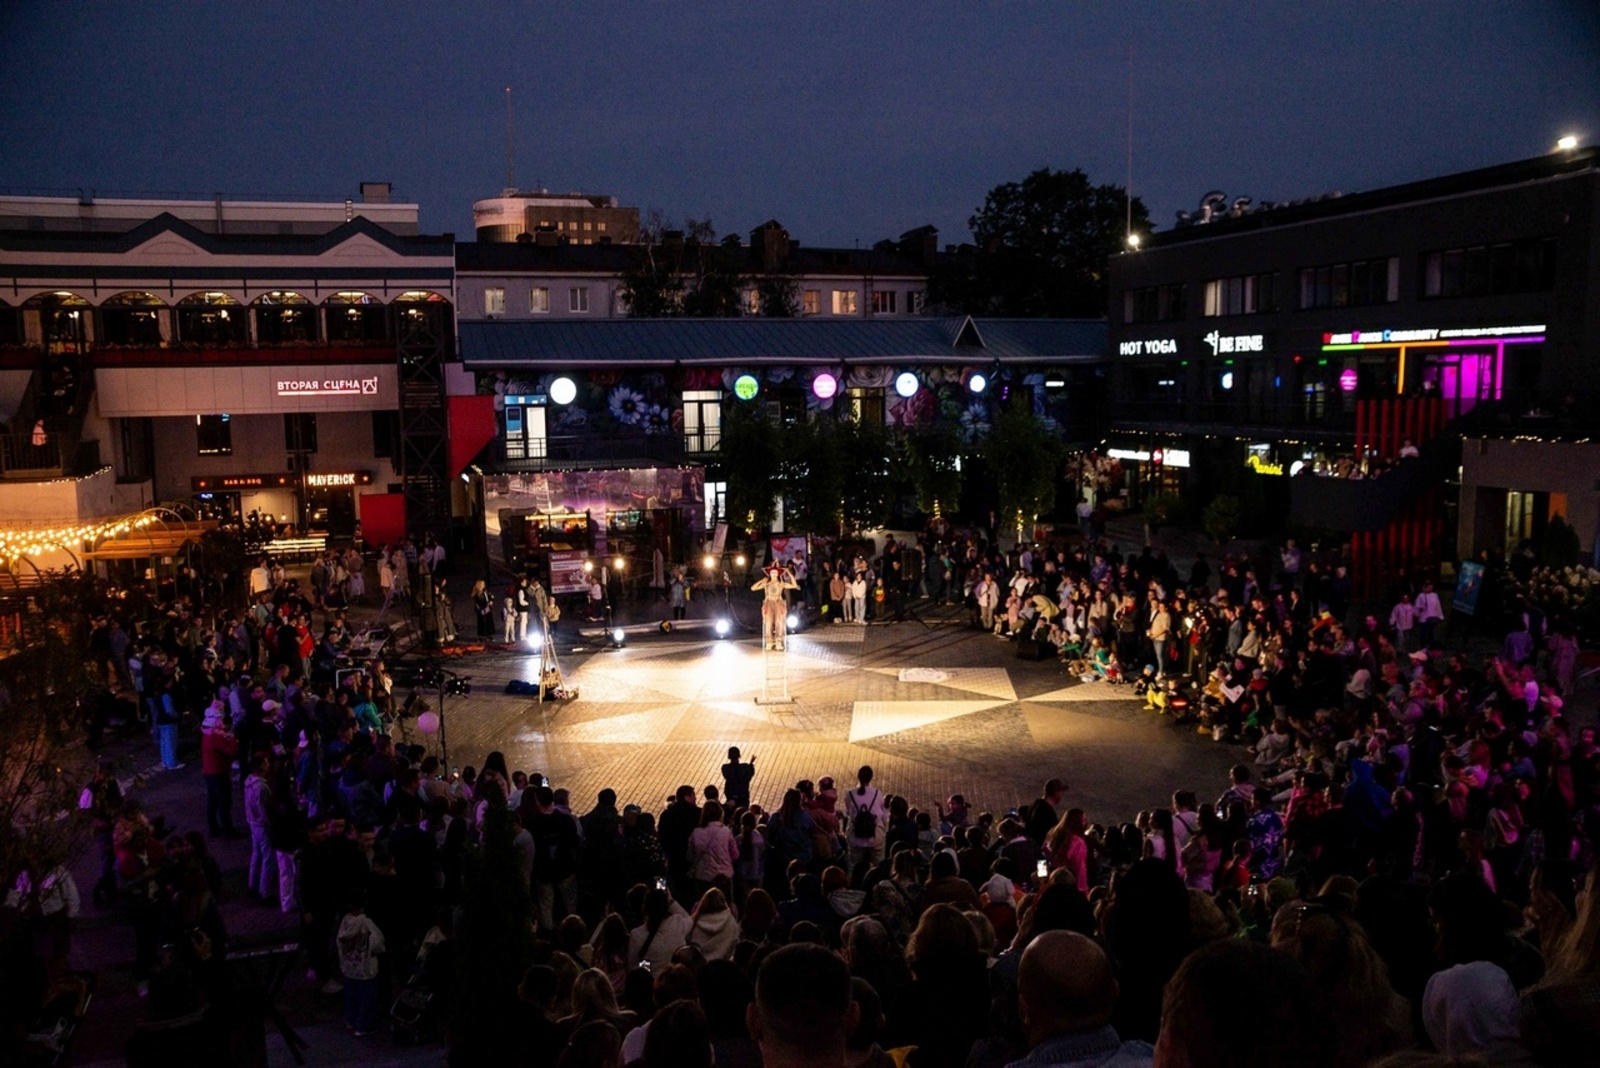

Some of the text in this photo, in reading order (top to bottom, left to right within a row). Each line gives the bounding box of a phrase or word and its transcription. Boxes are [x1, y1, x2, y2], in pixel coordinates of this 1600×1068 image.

[1119, 339, 1177, 356] HOT YOGA
[1235, 335, 1263, 352] FINE
[277, 380, 318, 390] ВТОРАЯ
[308, 474, 355, 486] MAVERICK
